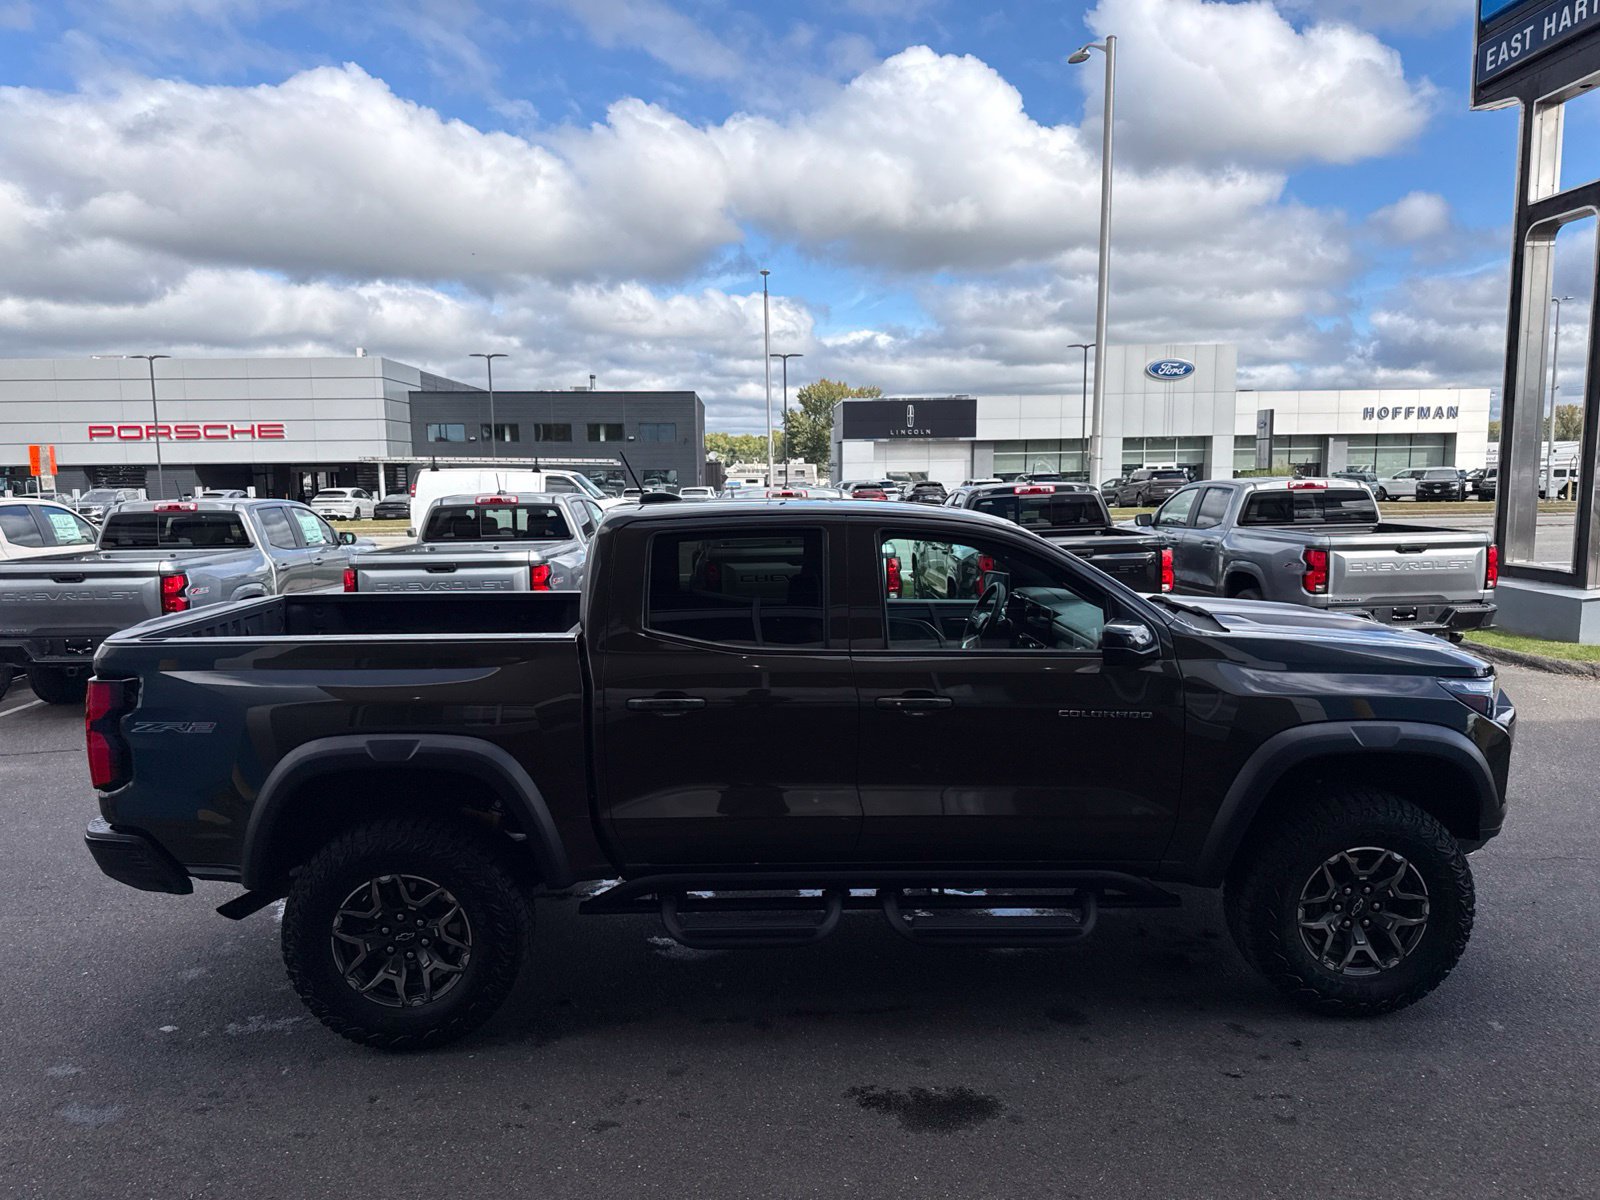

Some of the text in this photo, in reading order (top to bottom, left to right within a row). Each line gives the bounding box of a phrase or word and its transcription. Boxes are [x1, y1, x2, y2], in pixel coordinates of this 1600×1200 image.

[1485, 25, 1535, 72] EAST
[1362, 406, 1460, 421] HOFFMAN
[88, 423, 287, 441] PORSCHE
[1348, 560, 1474, 573] CHEVROLET
[374, 580, 511, 592] CHEVROLET
[0, 591, 139, 602] CHEVROLET
[1057, 709, 1153, 719] COLORADO
[130, 721, 217, 734] ZR2
